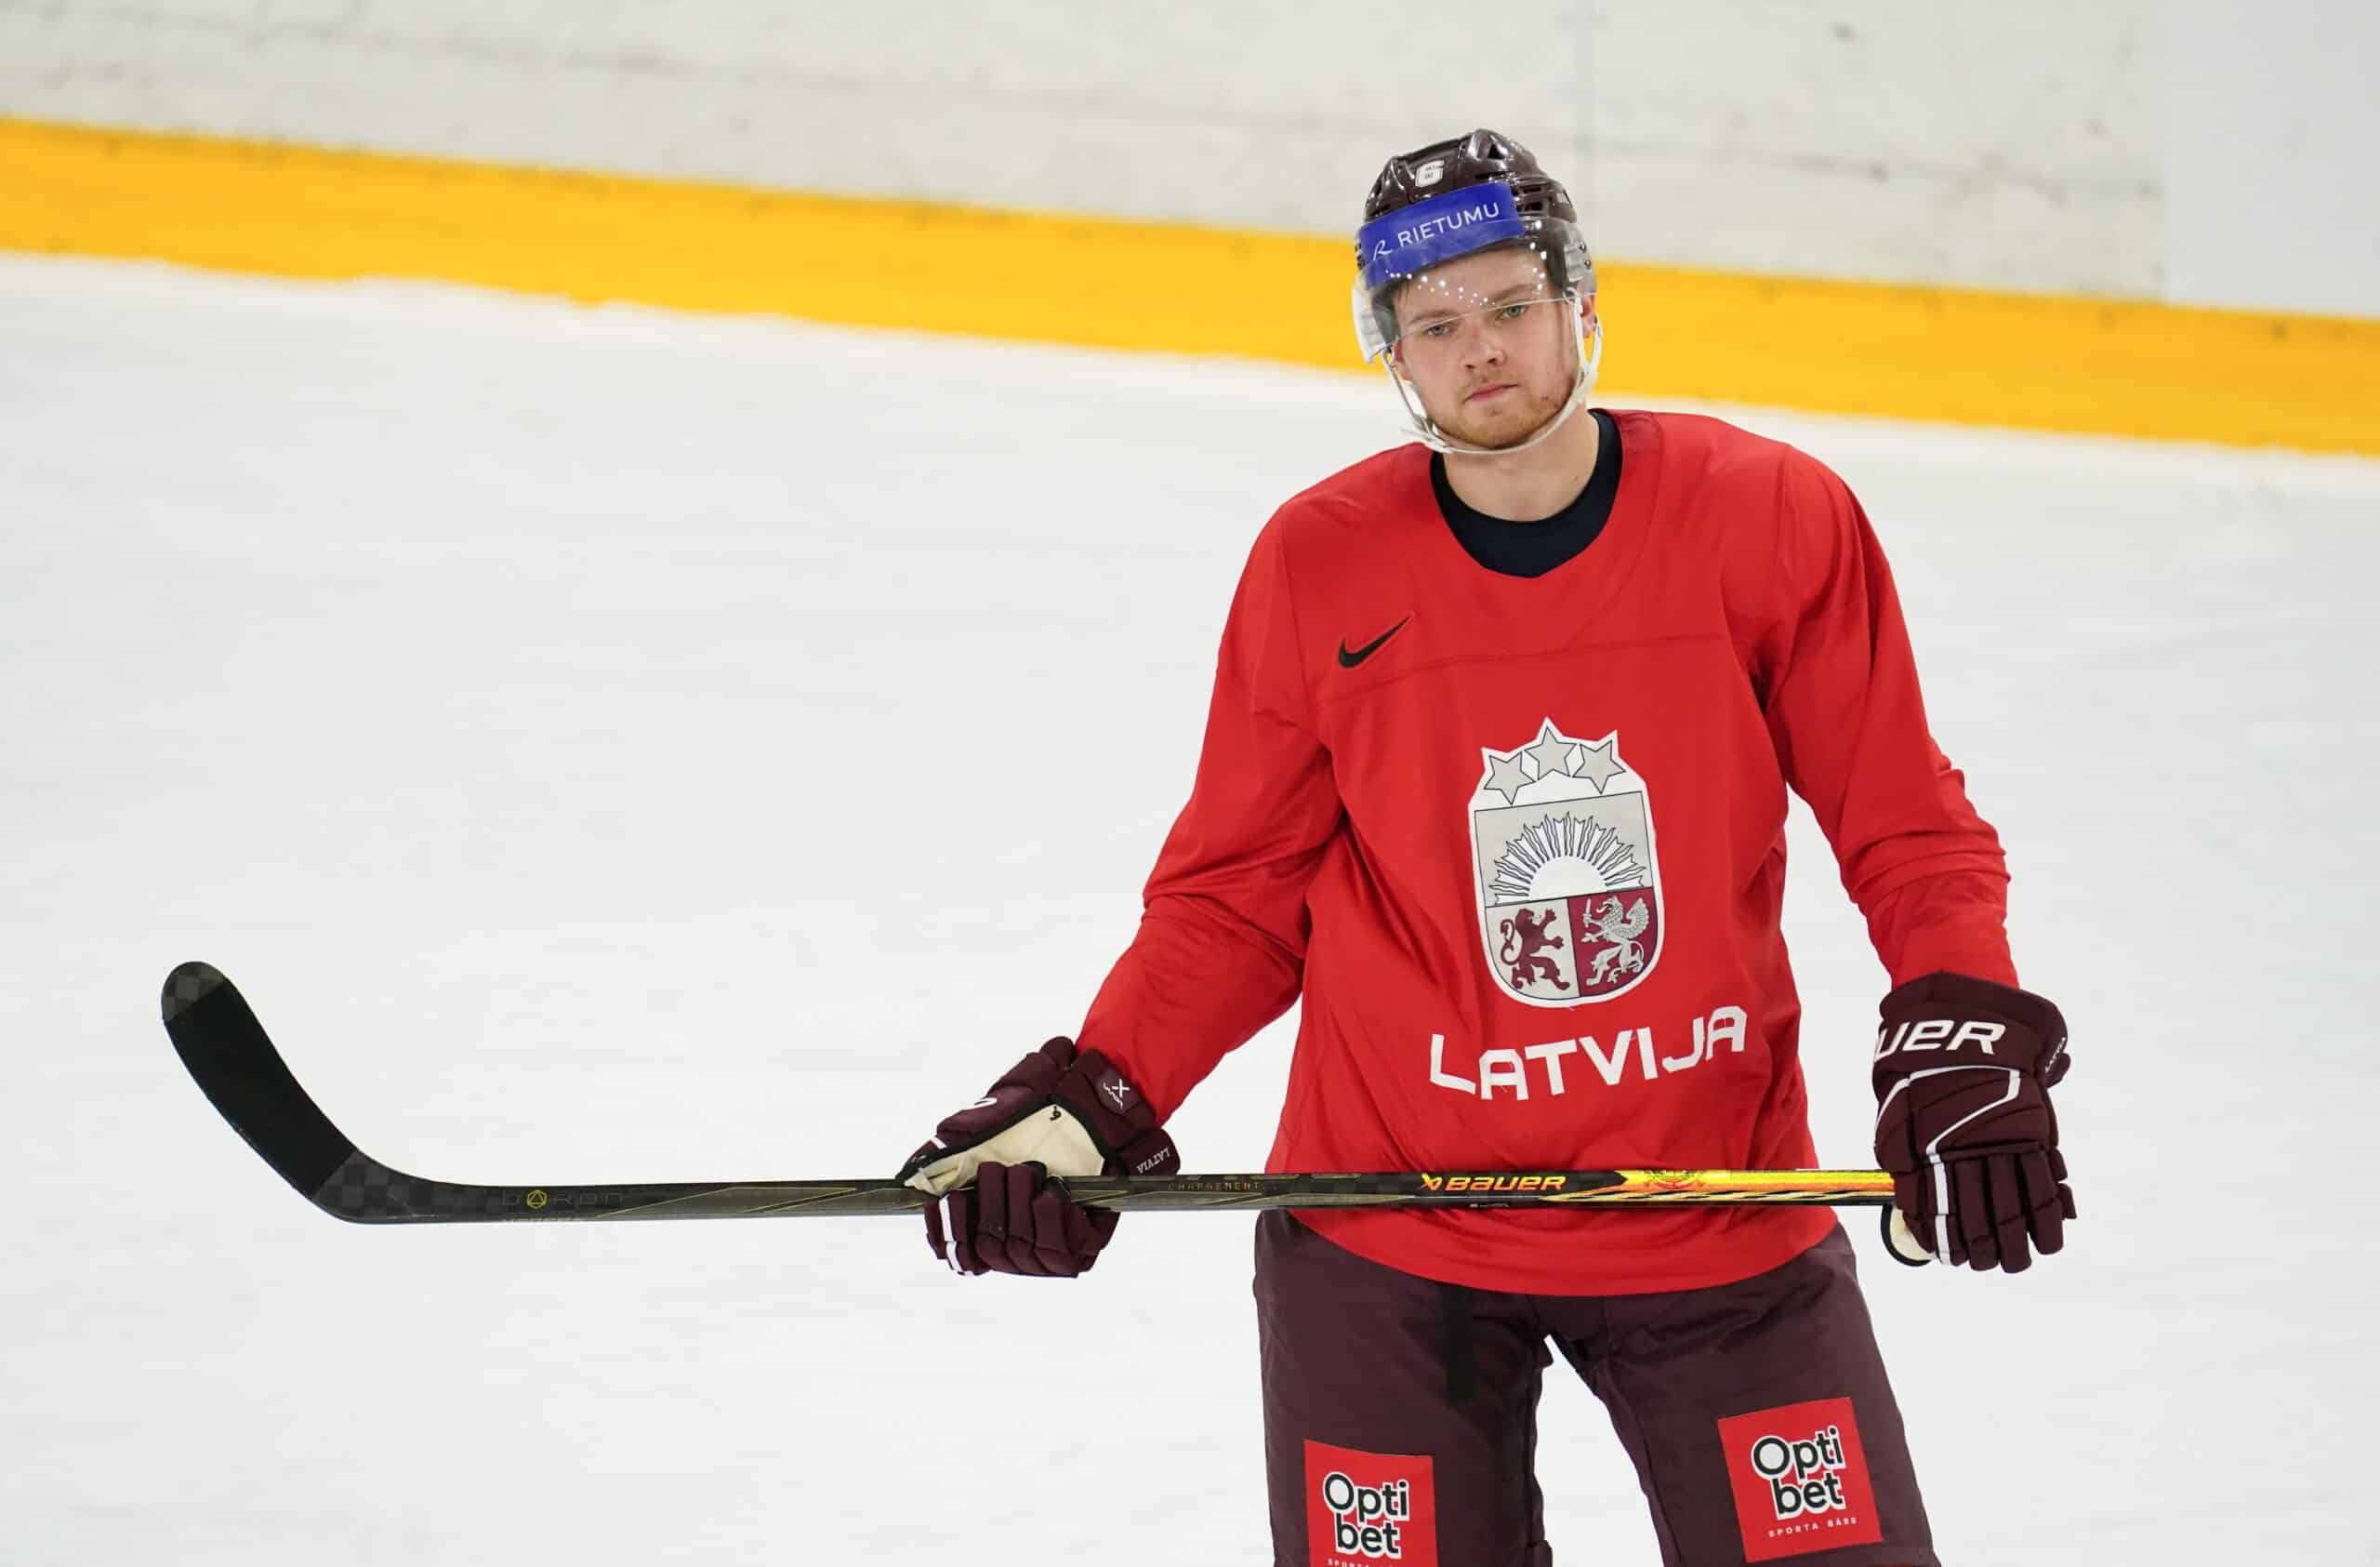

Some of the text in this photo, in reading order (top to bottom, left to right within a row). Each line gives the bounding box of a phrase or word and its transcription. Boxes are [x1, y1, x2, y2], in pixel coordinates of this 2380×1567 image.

[1397, 202, 1500, 248] RIETUMU
[1429, 1004, 1748, 1101] LATVIJA
[1752, 1427, 1844, 1481] Opti
[1324, 1472, 1408, 1524] Opti
[1772, 1472, 1844, 1516] bet
[1335, 1512, 1401, 1556] bet
